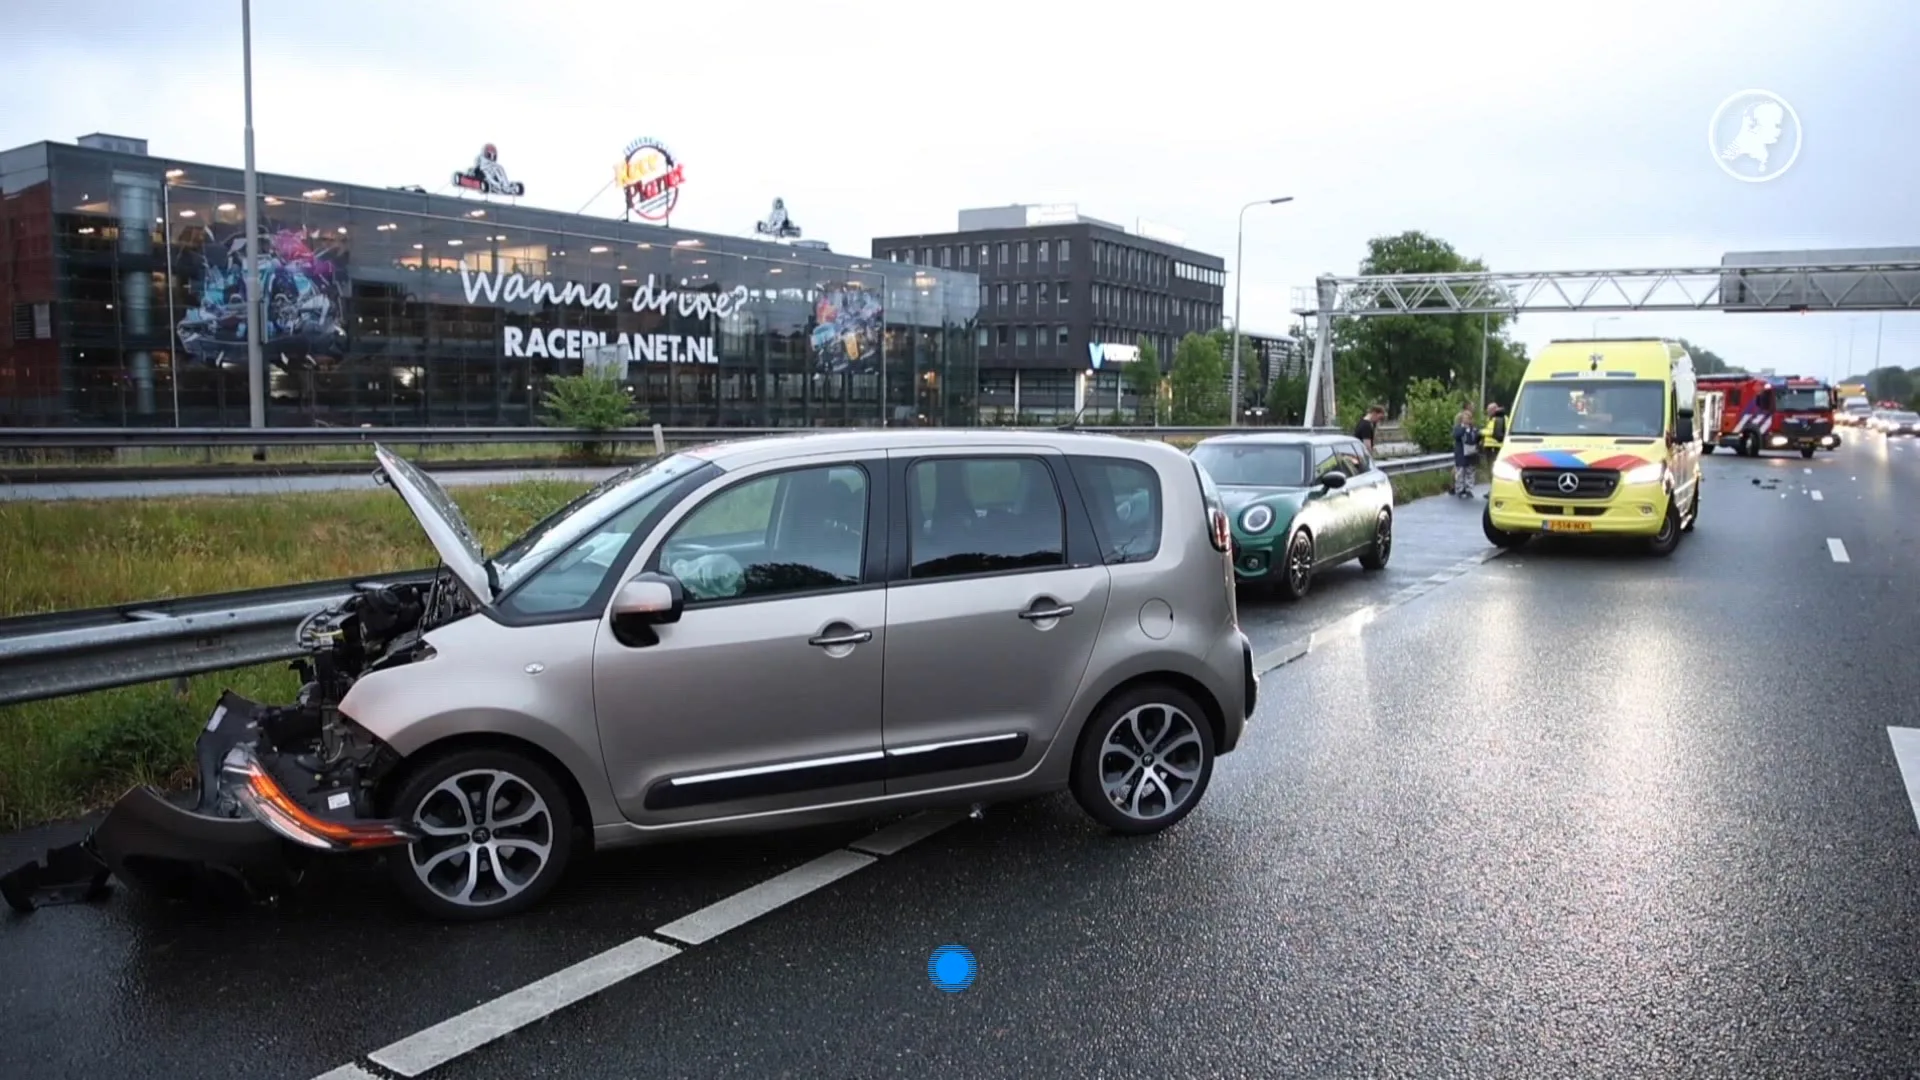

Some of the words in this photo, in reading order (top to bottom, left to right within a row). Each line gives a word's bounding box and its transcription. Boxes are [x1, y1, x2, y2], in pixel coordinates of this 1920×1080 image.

[623, 163, 686, 208] Planet
[459, 258, 618, 310] Wanna
[632, 273, 749, 320] drive?
